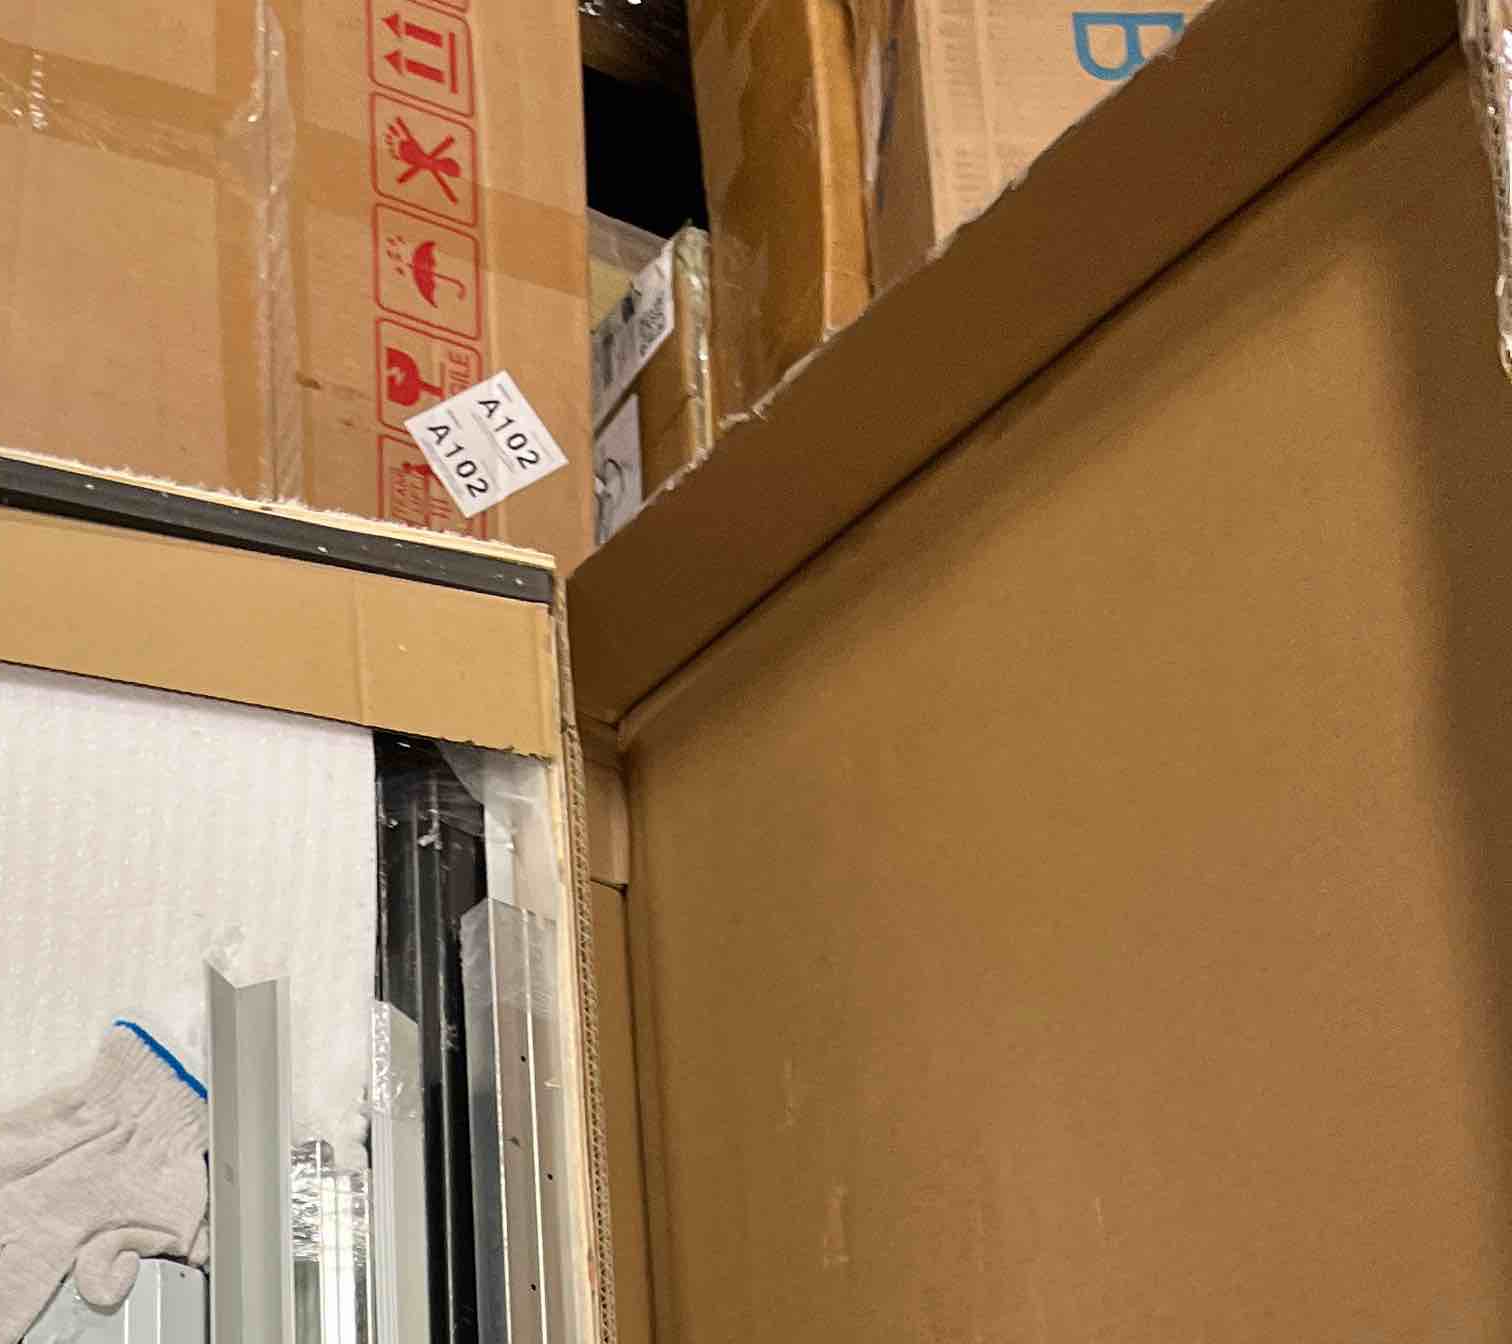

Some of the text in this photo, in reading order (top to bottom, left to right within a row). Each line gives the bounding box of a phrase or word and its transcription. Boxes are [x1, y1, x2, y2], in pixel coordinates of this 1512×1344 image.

[1072, 11, 1185, 81] B
[426, 424, 489, 498] A102
[477, 399, 540, 470] A102
